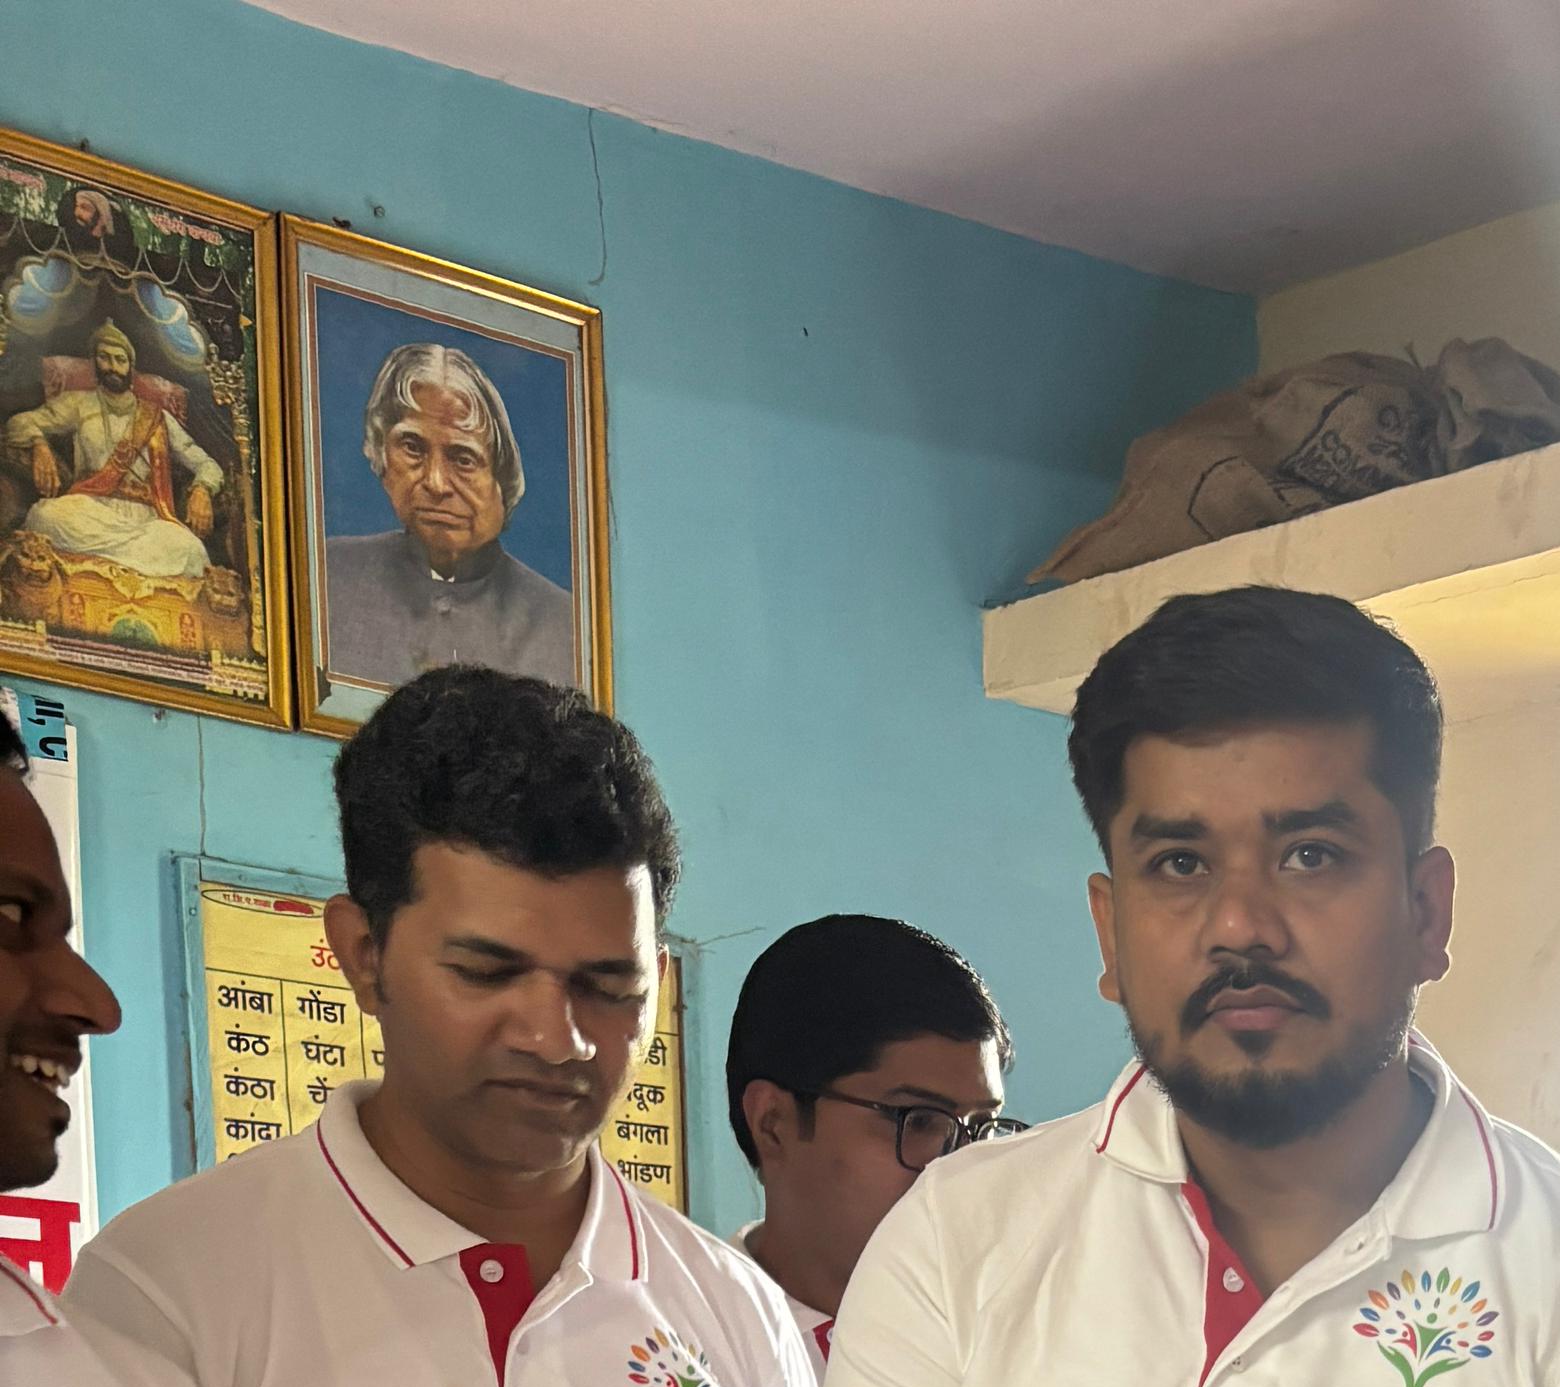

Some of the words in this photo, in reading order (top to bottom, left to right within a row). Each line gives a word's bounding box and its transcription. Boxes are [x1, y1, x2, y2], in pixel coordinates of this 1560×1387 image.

[217, 980, 274, 1015] आंबा
[296, 989, 346, 1025] गोंडा
[224, 1023, 271, 1057] कंठ
[300, 1035, 346, 1067] घंटा
[645, 1036, 668, 1067] डी
[223, 1066, 276, 1101] कंठा
[627, 1082, 665, 1113] दूक
[615, 1114, 670, 1146] बंगला
[617, 1154, 672, 1185] भांडण
